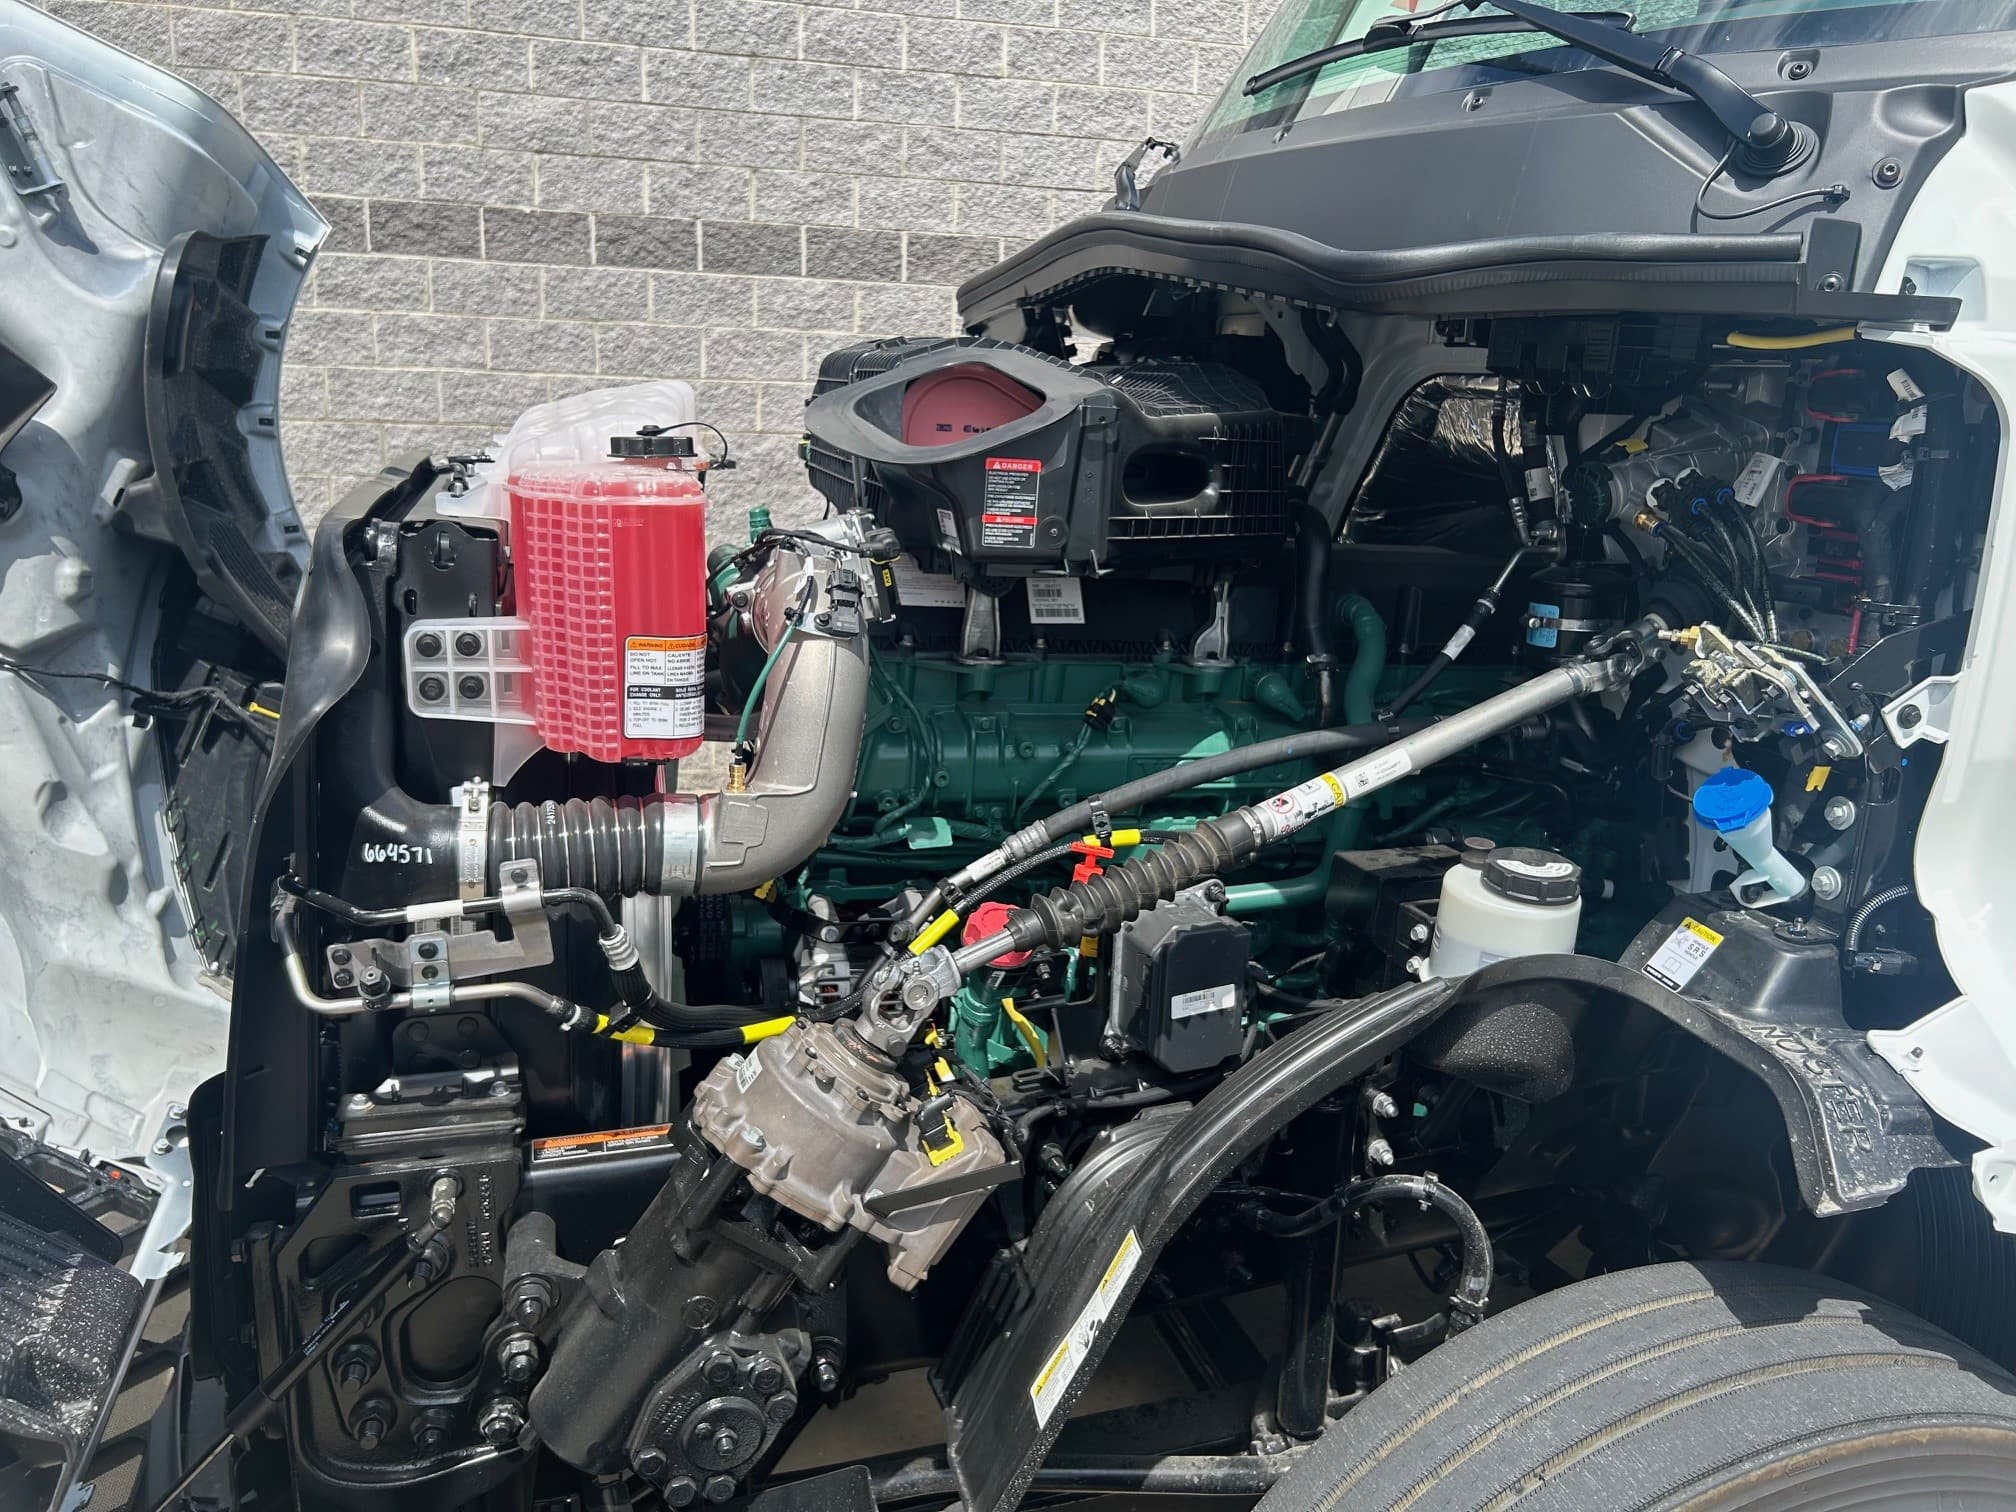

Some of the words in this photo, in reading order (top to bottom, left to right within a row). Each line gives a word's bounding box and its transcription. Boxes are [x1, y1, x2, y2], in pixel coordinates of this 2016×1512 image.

[1001, 462, 1034, 471] DANGER
[362, 842, 433, 864] 664571
[1692, 925, 1716, 942] CAUTION
[1750, 1026, 1810, 1053] NO
[1802, 1059, 1875, 1153] STEP
